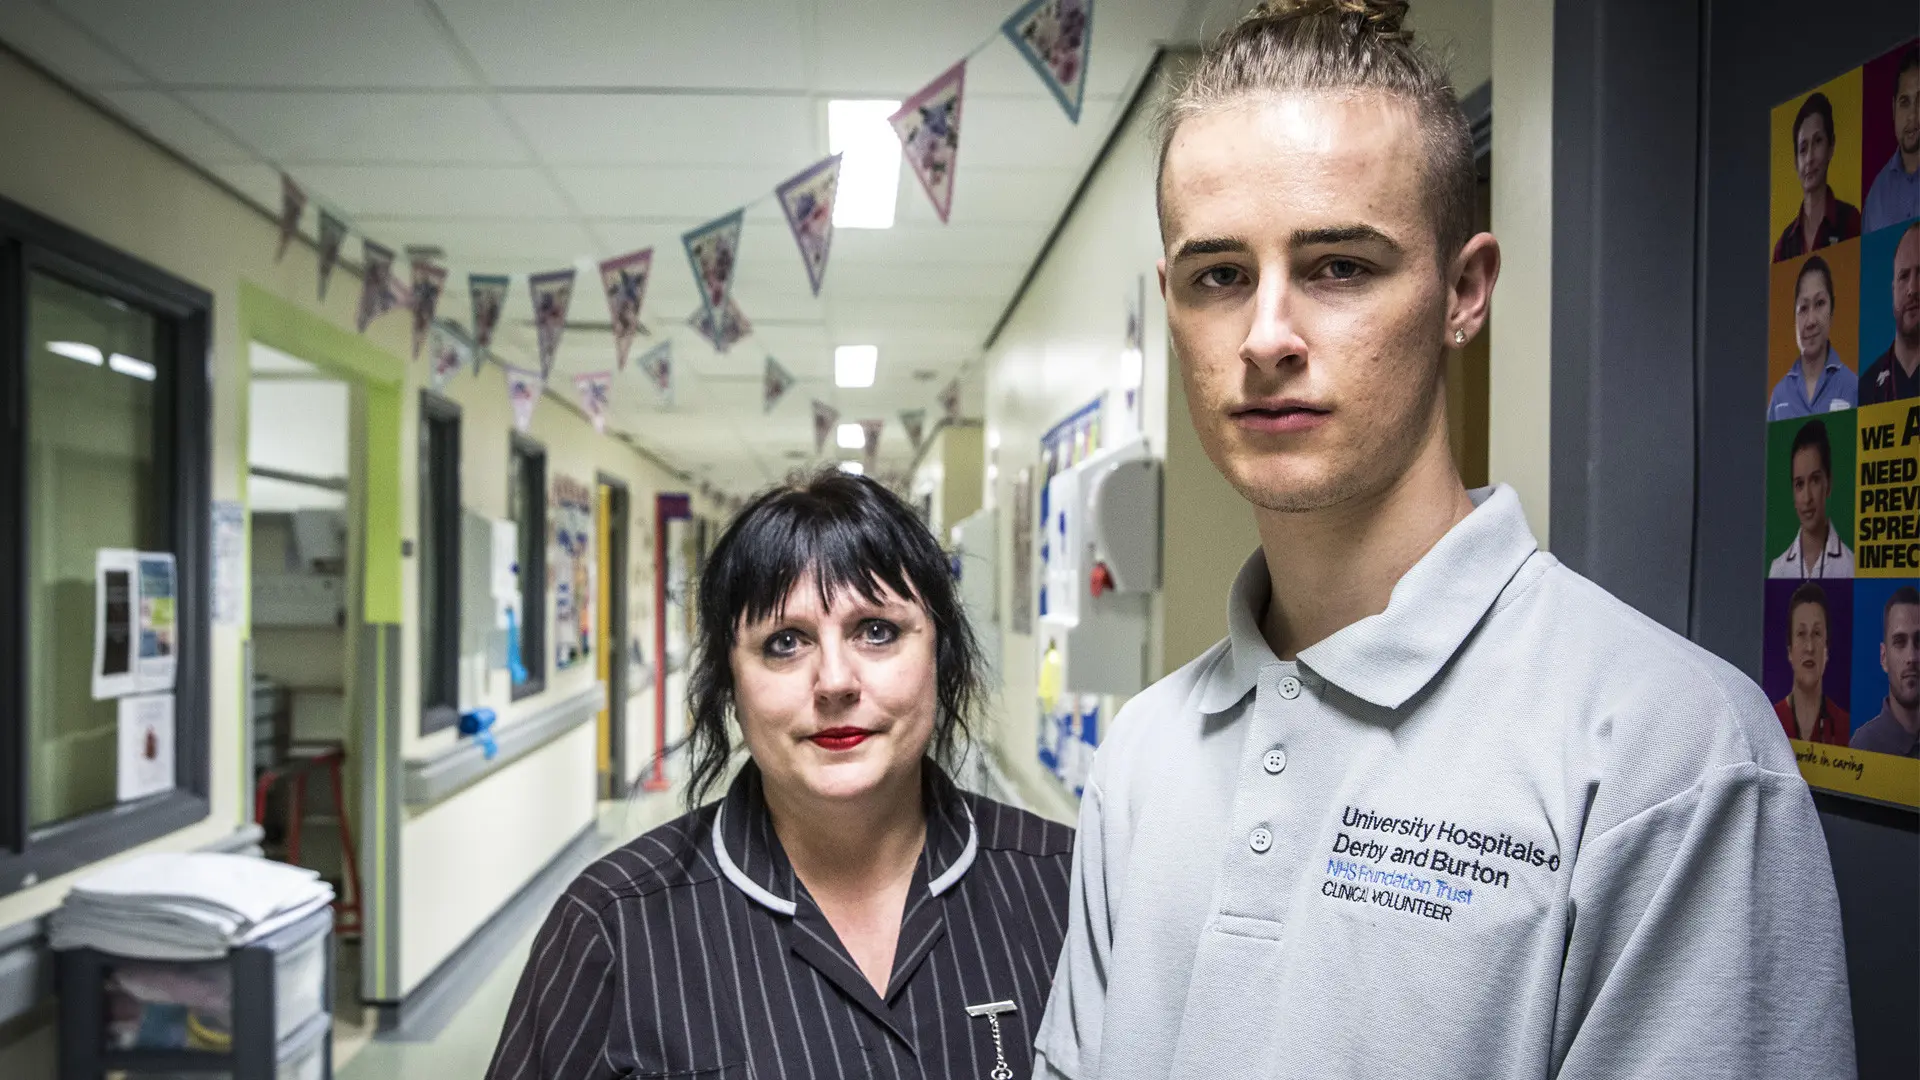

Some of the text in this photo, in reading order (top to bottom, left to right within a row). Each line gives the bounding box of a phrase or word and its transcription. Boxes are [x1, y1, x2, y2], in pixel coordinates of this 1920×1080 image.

[1861, 424, 1895, 451] WE
[1861, 458, 1918, 486] NEED
[1860, 487, 1920, 514] PREV
[1833, 756, 1864, 780] caring
[1342, 805, 1436, 842] University
[1436, 821, 1545, 867] Hospitals
[1332, 832, 1510, 889] Derby and Burton
[1326, 859, 1357, 881] NHS
[1435, 879, 1473, 905] Trust
[1371, 889, 1453, 923] VOLUNTEER
